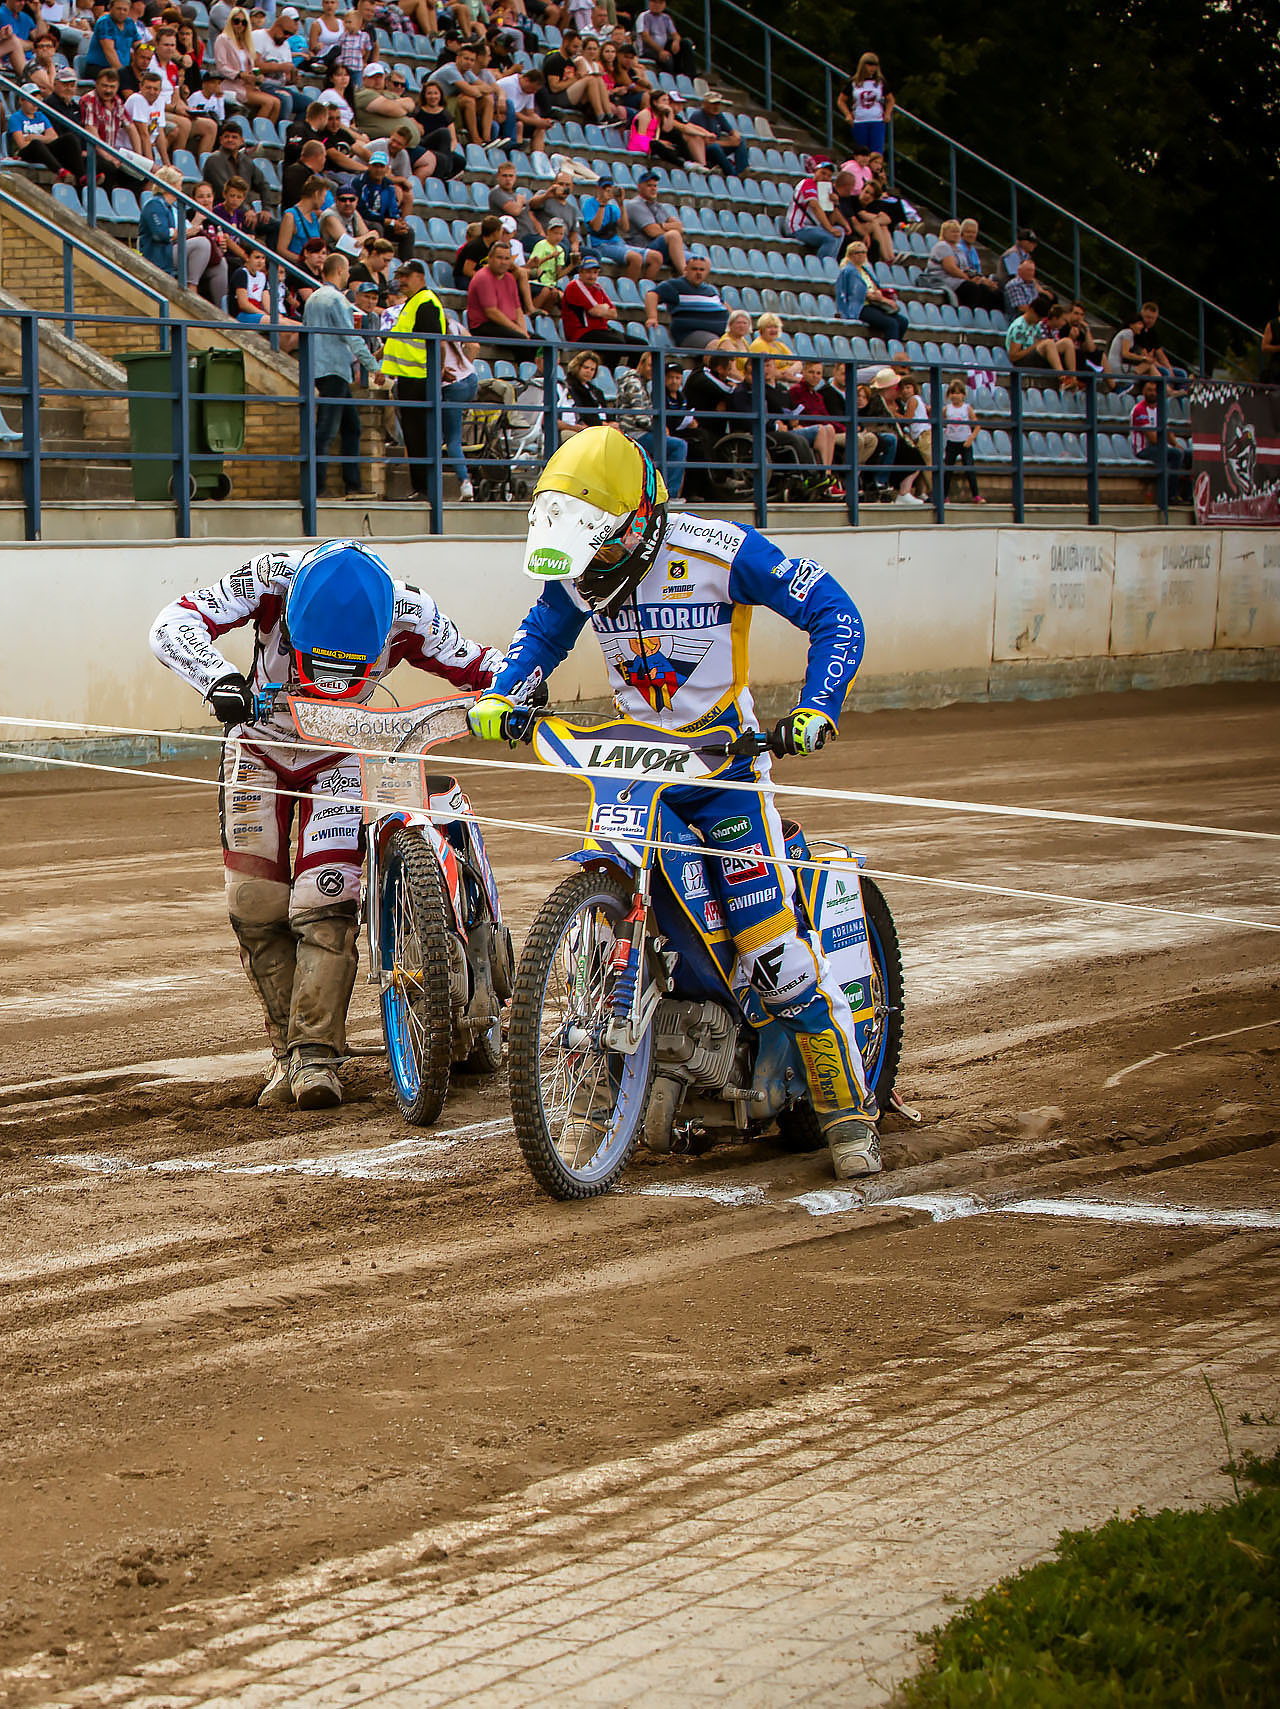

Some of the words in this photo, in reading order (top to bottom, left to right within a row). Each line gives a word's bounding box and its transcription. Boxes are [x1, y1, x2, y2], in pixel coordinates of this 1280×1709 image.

[588, 524, 613, 551] Nice
[679, 522, 740, 547] NICOLAUS
[529, 554, 569, 571] Marwit
[646, 602, 720, 629] TORUŃ
[319, 679, 343, 690] BELL
[588, 744, 690, 773] LAVOR
[595, 806, 646, 826] FST
[712, 818, 750, 840] Marwit
